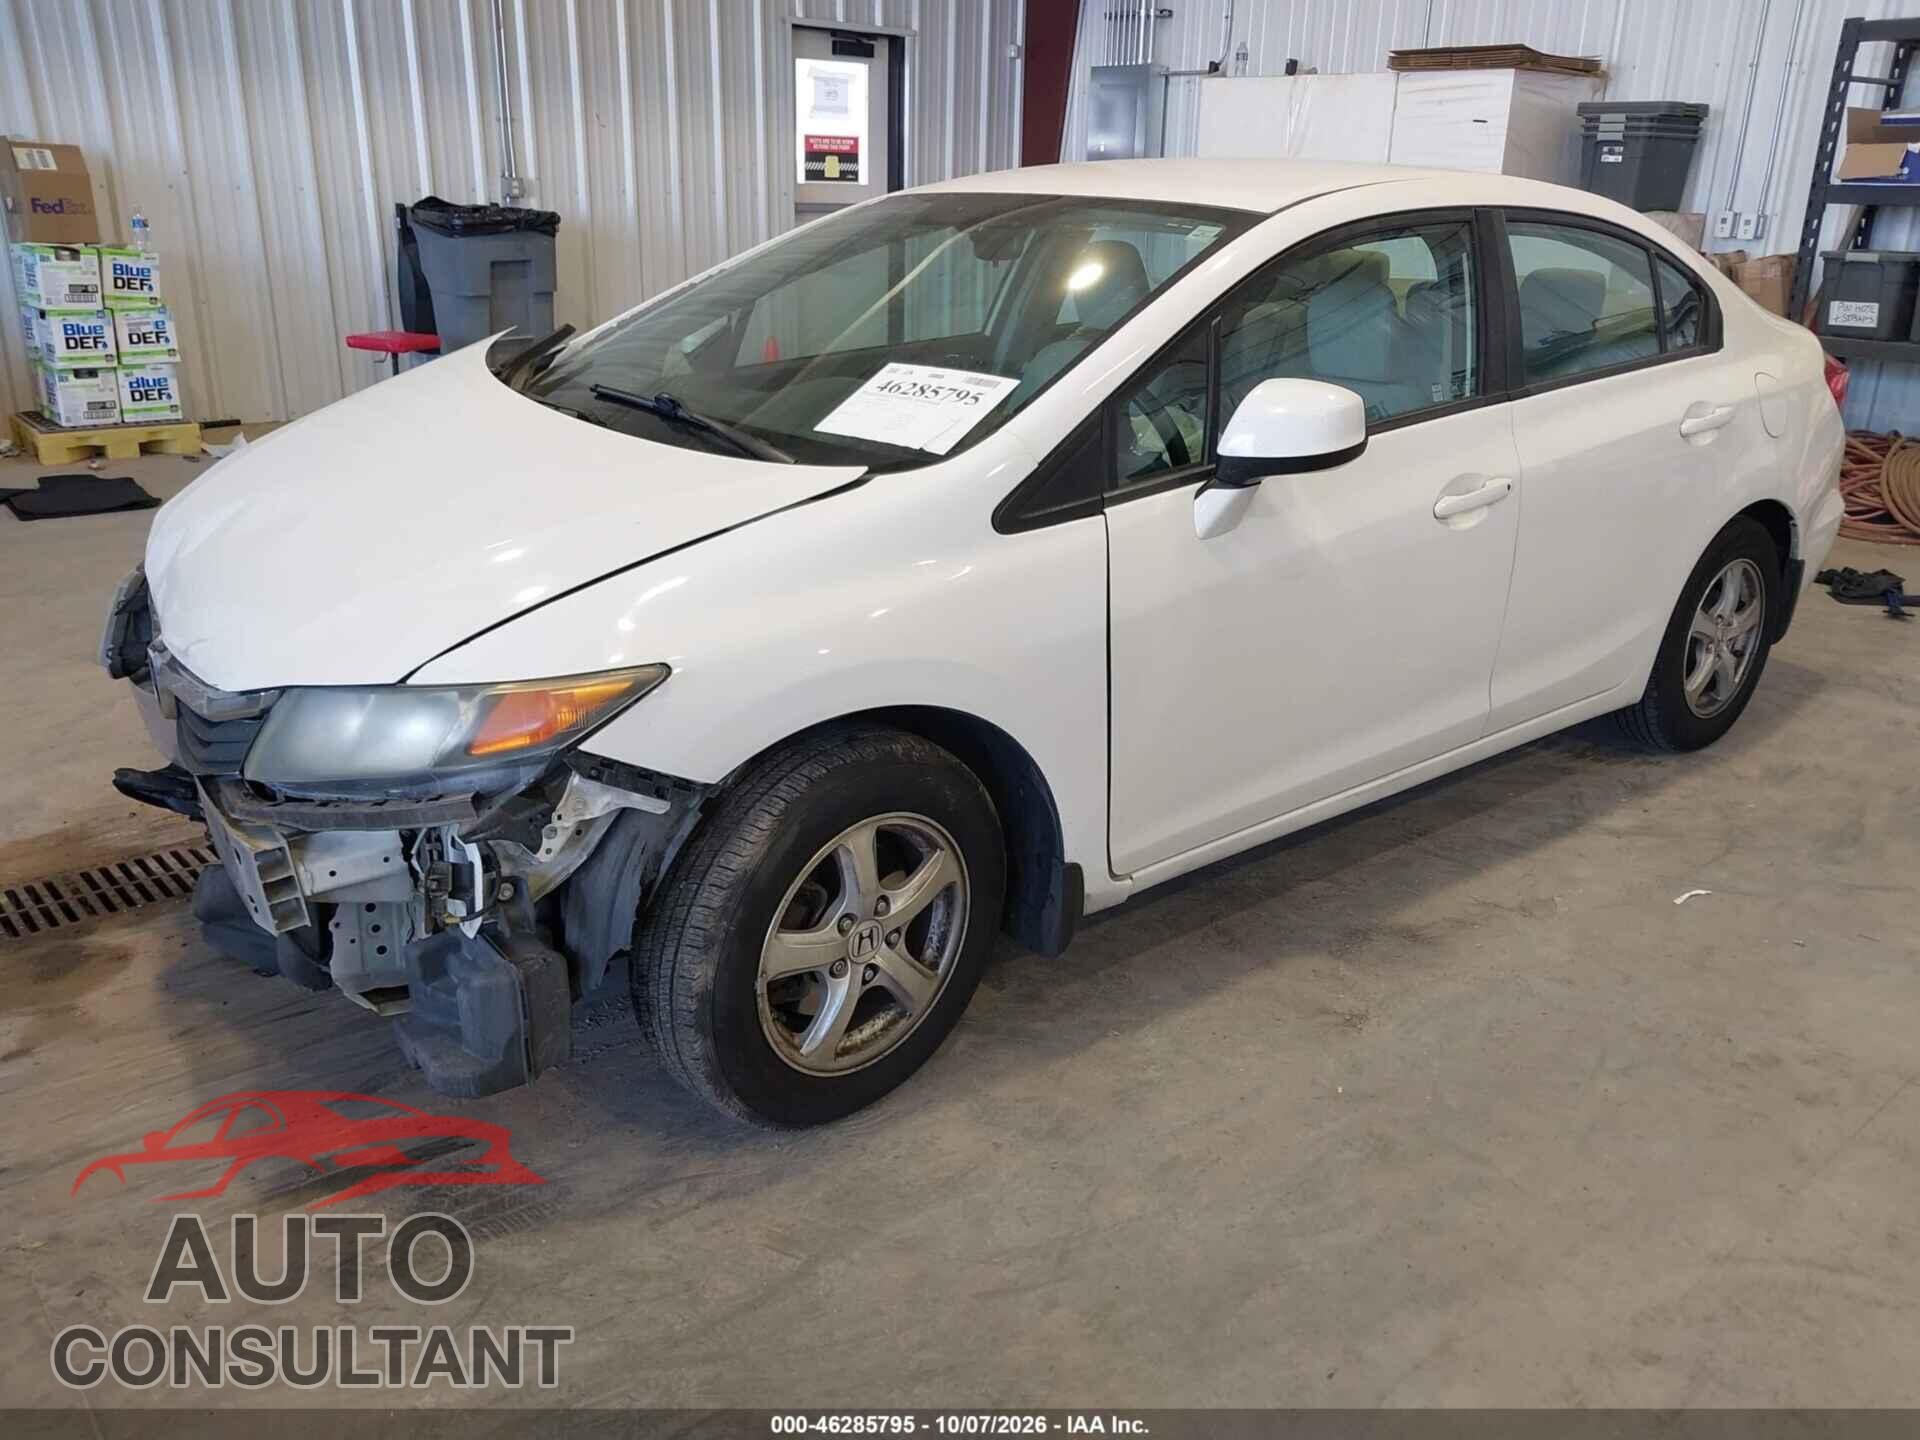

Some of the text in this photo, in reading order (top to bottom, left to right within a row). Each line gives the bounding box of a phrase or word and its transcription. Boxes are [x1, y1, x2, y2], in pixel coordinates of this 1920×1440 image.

[112, 263, 151, 278] Blue
[113, 278, 150, 291] DEF
[63, 323, 104, 336] Blue
[65, 336, 105, 350] DEF
[128, 331, 166, 345] DEF
[131, 389, 170, 402] DEF
[877, 379, 985, 406] 46285795
